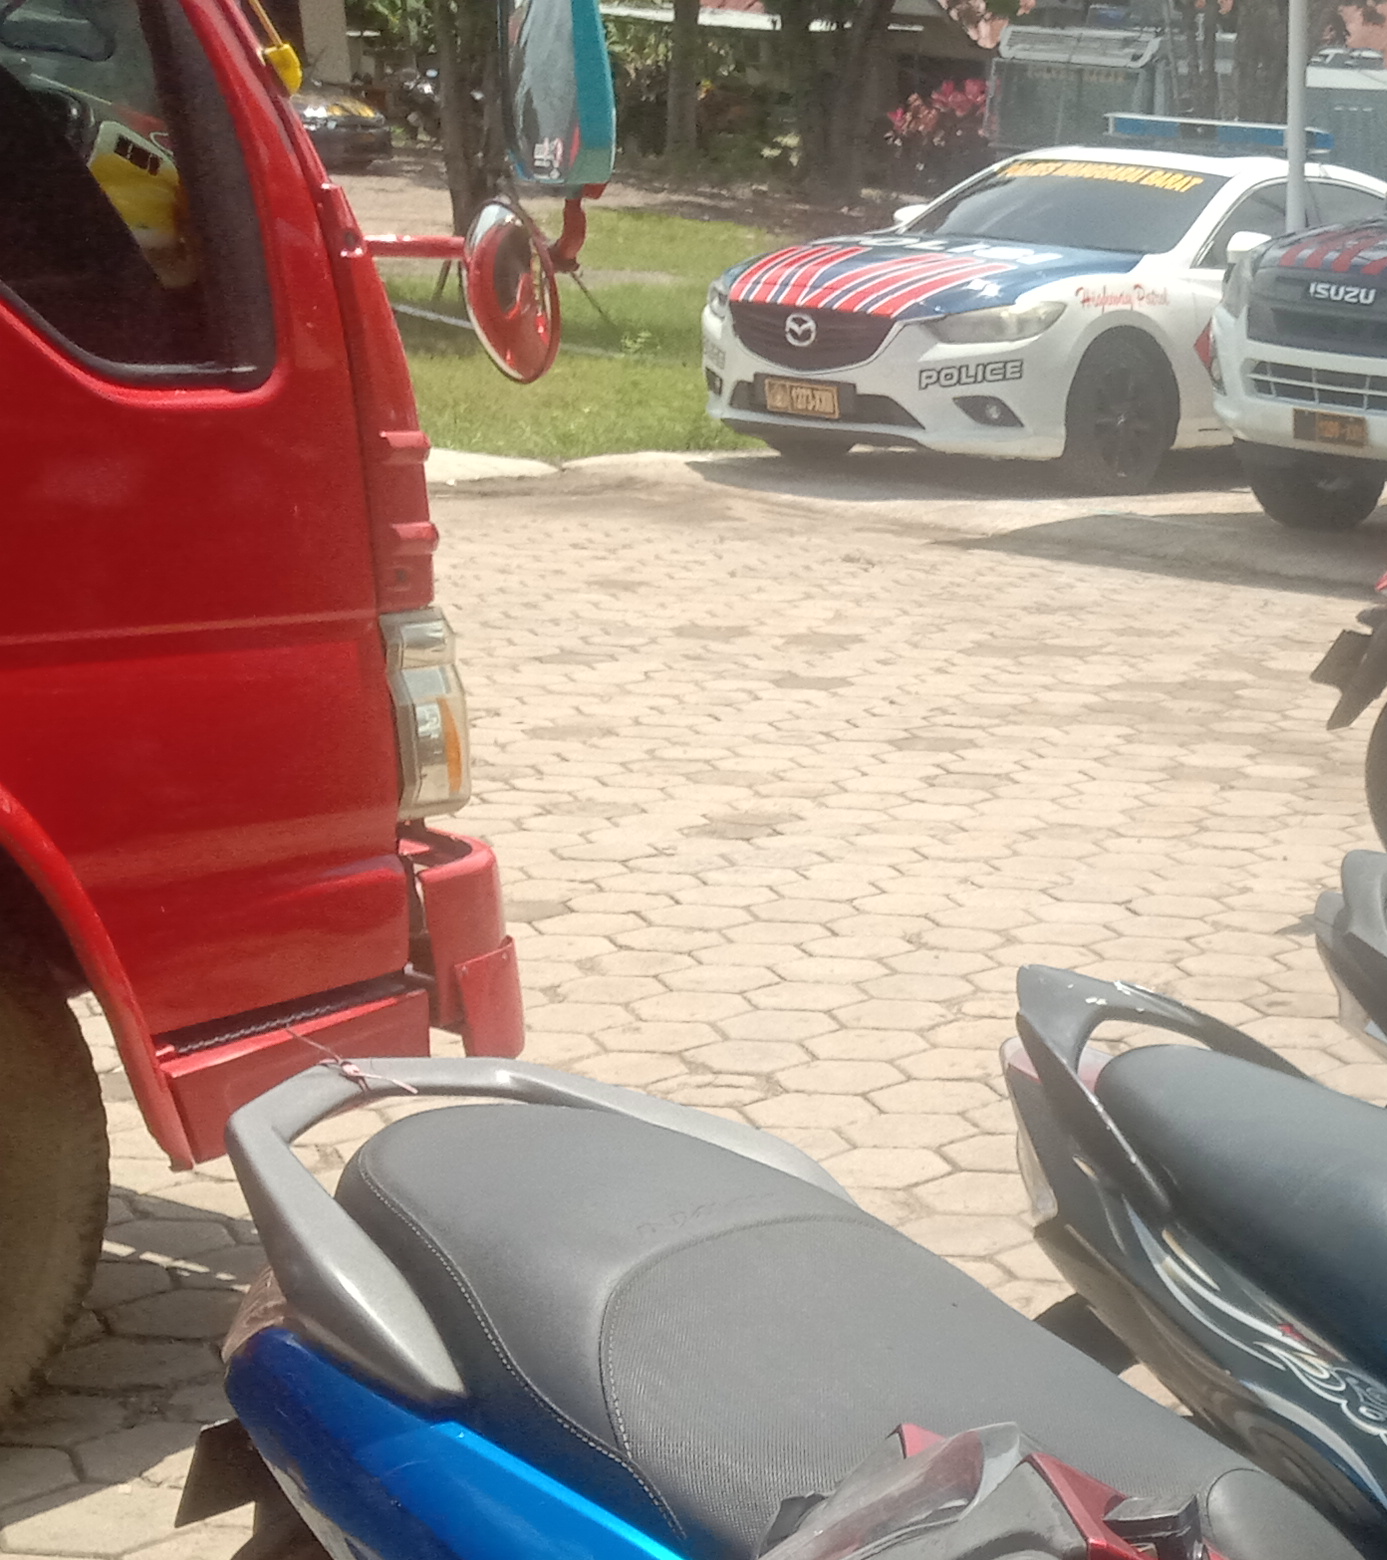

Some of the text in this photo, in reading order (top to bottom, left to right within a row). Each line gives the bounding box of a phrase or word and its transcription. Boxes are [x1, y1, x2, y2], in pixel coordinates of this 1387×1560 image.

[1140, 169, 1204, 193] BARAT
[1309, 282, 1377, 305] ISUZU
[918, 359, 1024, 391] POLICE
